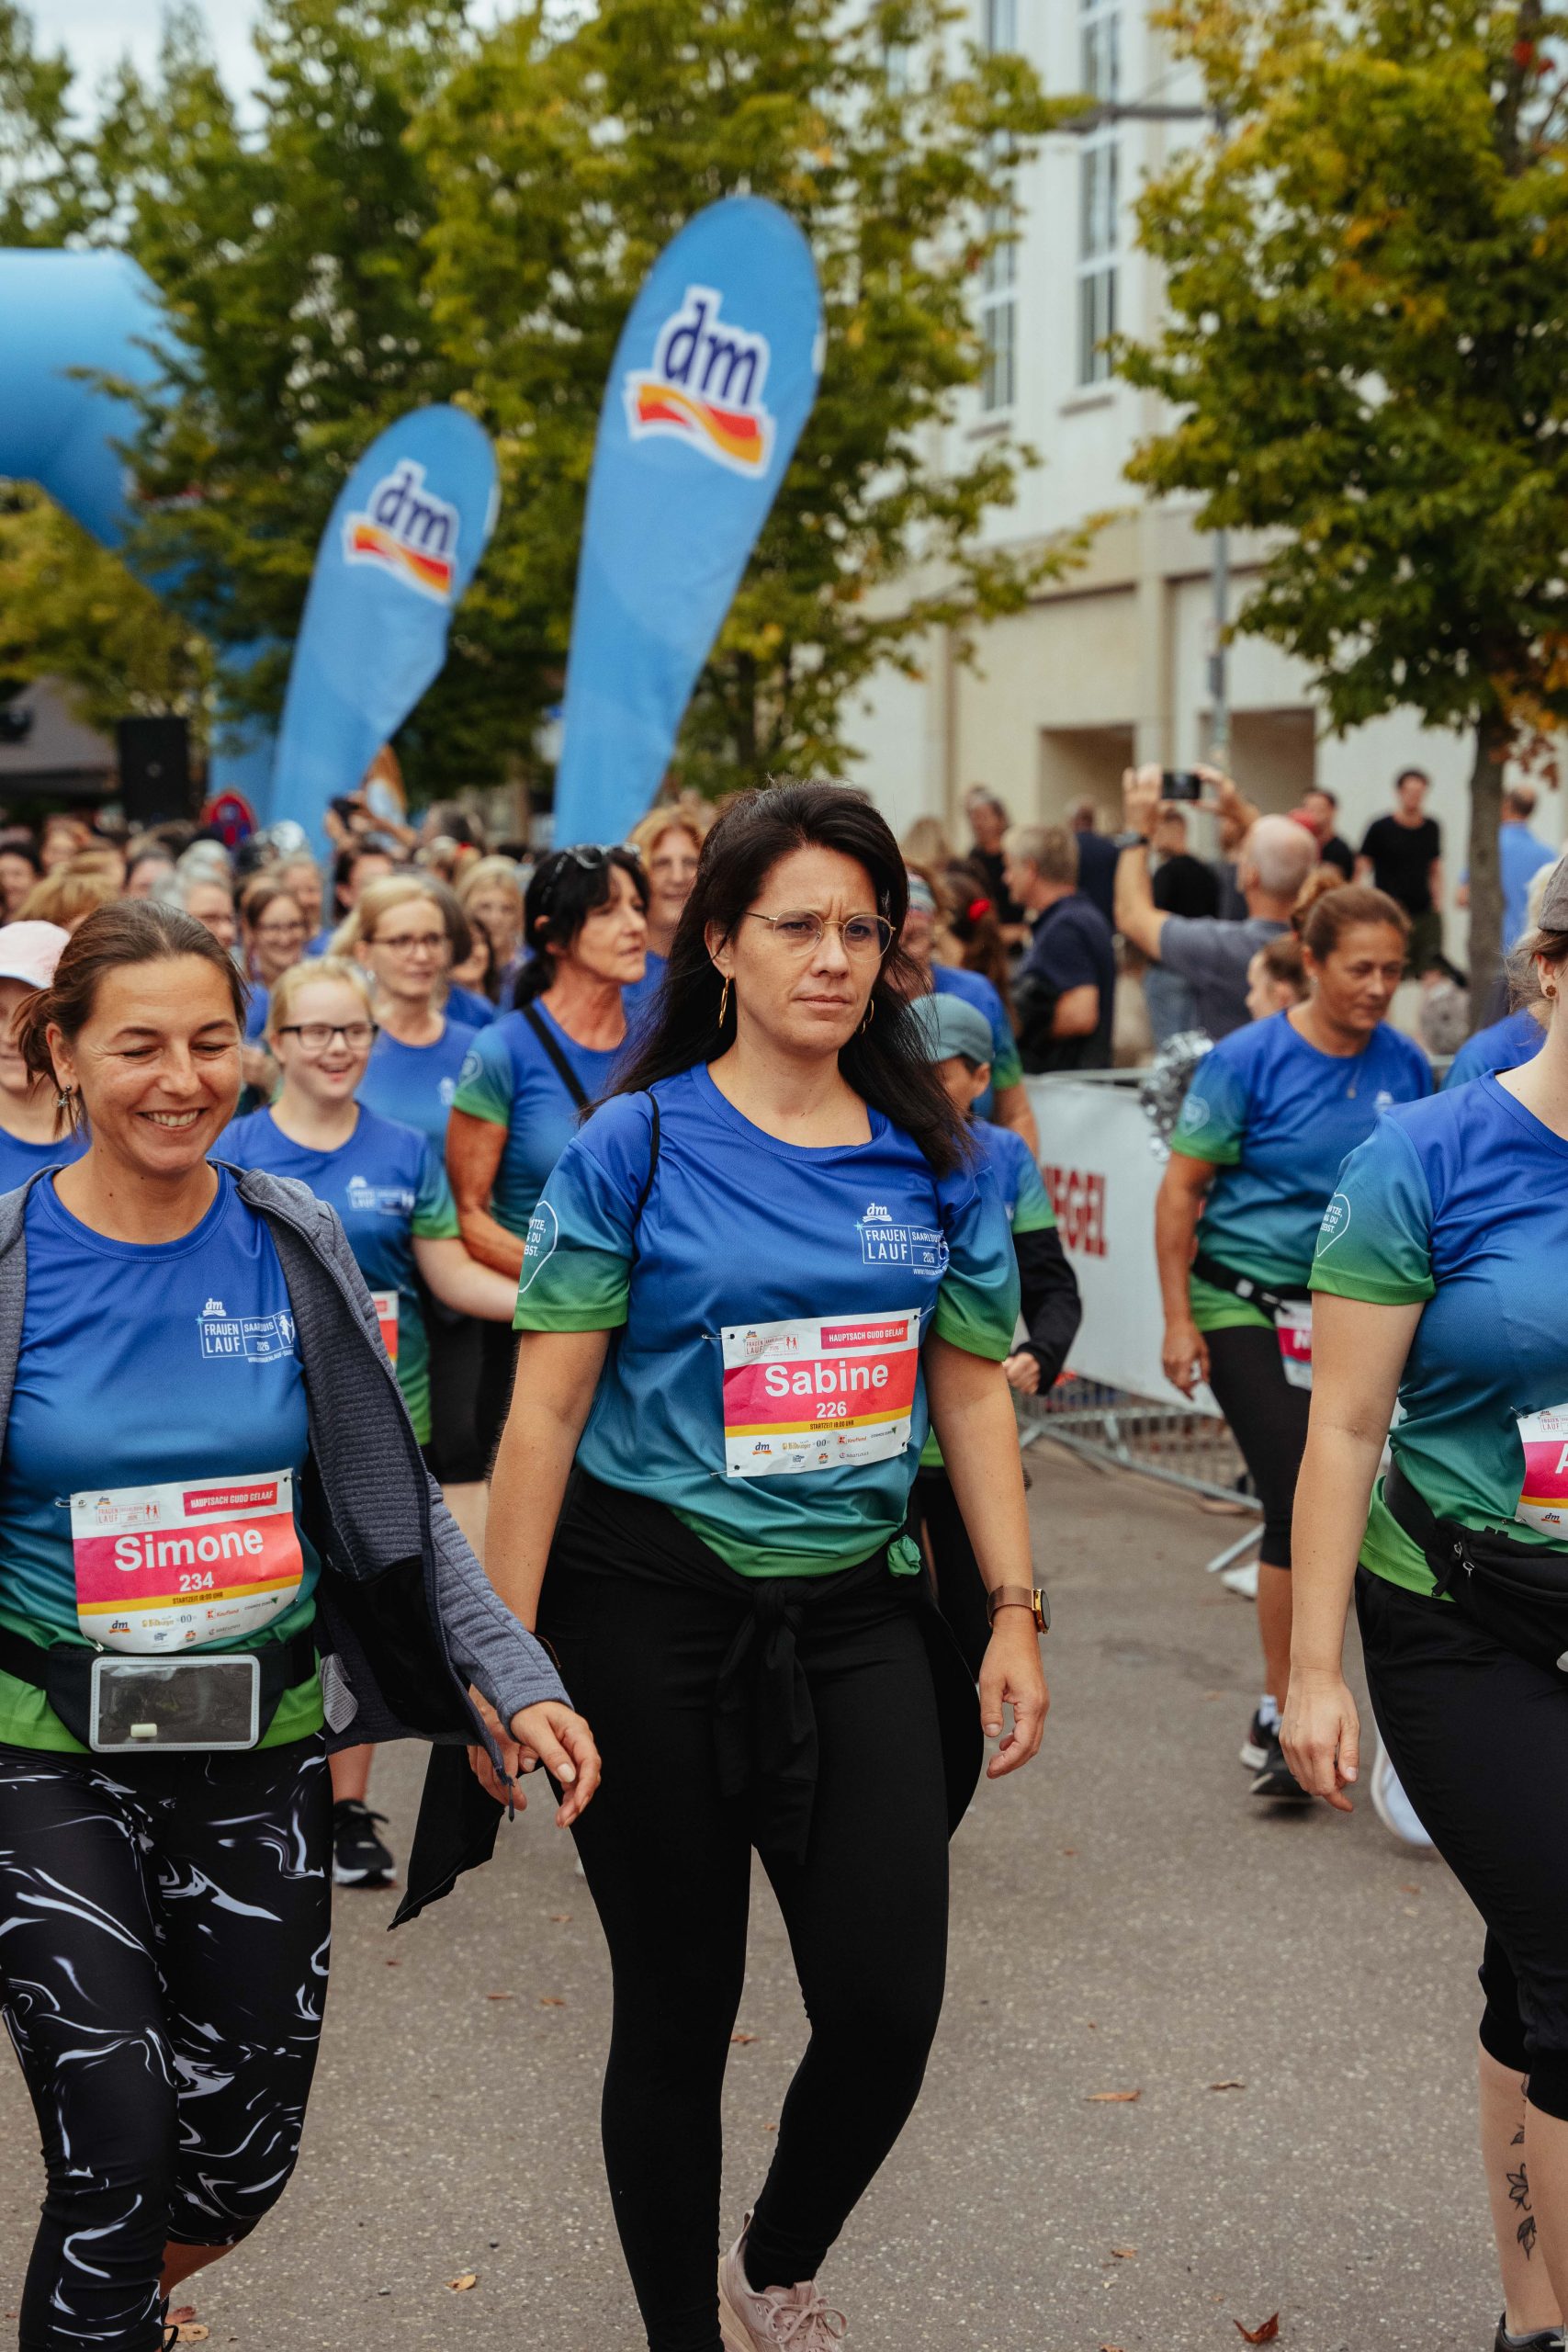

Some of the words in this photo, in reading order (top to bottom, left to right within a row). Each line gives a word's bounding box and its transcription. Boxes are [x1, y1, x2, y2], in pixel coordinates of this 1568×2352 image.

[663, 300, 759, 406] dm
[375, 472, 450, 552] dm
[866, 1203, 887, 1216] dm
[864, 1229, 907, 1242] FRAUEN
[867, 1243, 908, 1261] LAUF
[205, 1298, 222, 1310] dm
[204, 1323, 239, 1336] FRAUEN
[829, 1331, 865, 1342] HAUPTSACH
[205, 1337, 241, 1353] LAUF
[746, 1346, 763, 1355] LAUF
[764, 1361, 888, 1397] Sabine
[816, 1400, 848, 1419] 226
[755, 1442, 770, 1451] dm
[190, 1496, 229, 1509] HAUPTSACH
[250, 1490, 274, 1501] GELAAF
[1544, 1512, 1561, 1521] dm
[114, 1529, 264, 1572] Simone
[179, 1571, 214, 1592] 234
[111, 1620, 128, 1629] dm
